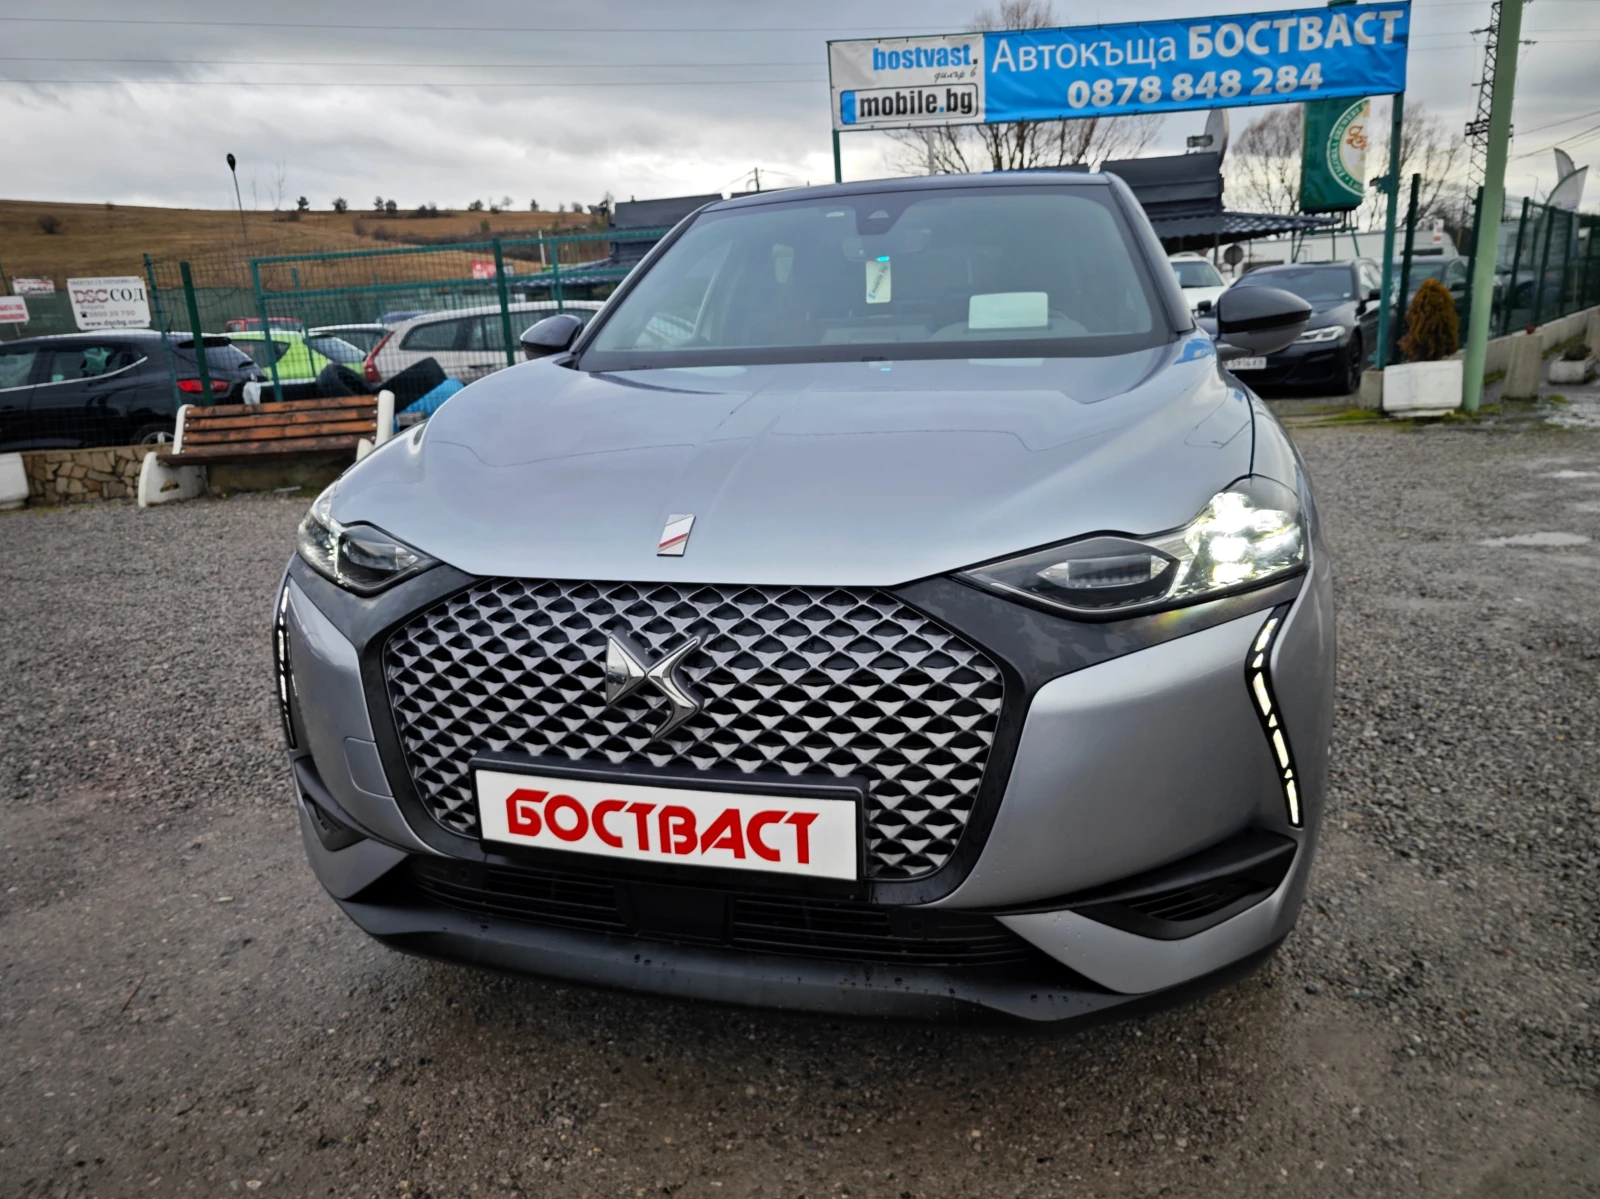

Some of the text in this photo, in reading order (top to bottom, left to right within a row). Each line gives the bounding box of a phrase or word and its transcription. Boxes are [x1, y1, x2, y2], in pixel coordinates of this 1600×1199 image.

[992, 10, 1403, 74] Автокъща БОСТВАСТ
[860, 88, 972, 117] mobile.bg
[1067, 63, 1323, 108] 0878 848 284
[73, 289, 108, 304] DSC
[506, 788, 820, 864] БОСТВАСТ
